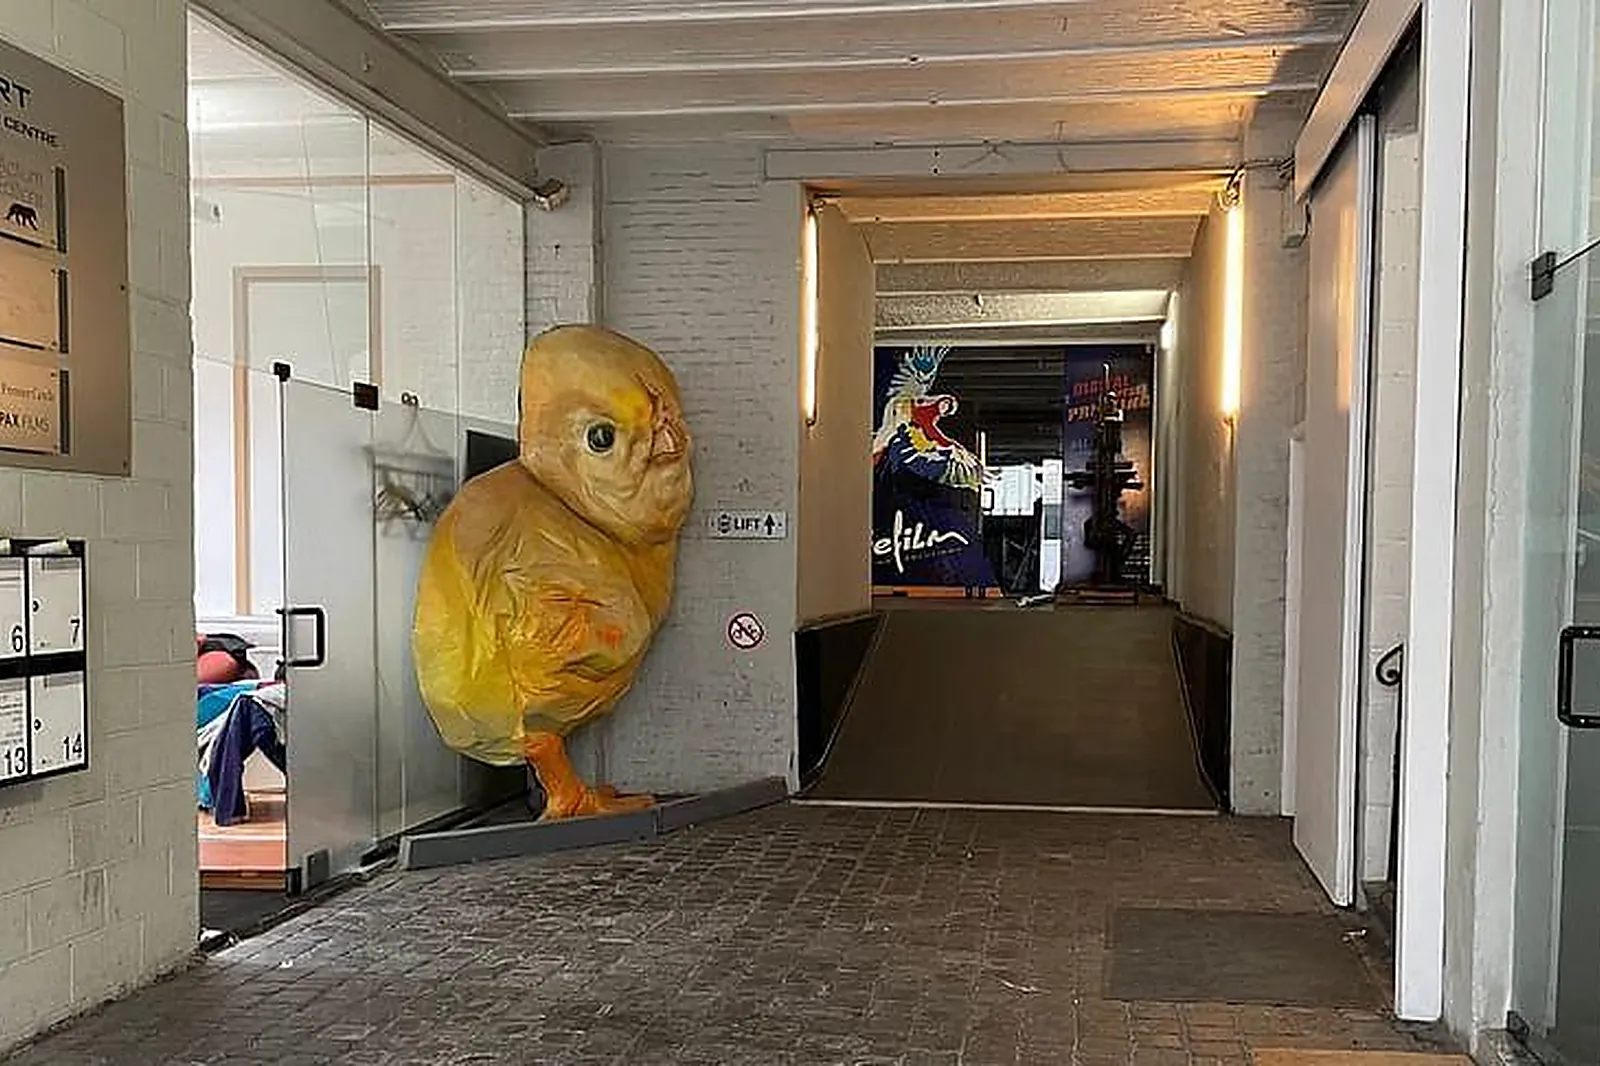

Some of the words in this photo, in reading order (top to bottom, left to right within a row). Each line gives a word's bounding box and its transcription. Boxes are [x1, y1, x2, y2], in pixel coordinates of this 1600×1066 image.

[4, 116, 60, 148] CENTRE
[734, 517, 760, 530] LIFT
[11, 625, 23, 652] 6
[70, 618, 81, 644] 7
[4, 746, 26, 775] 13
[63, 734, 82, 761] 14
